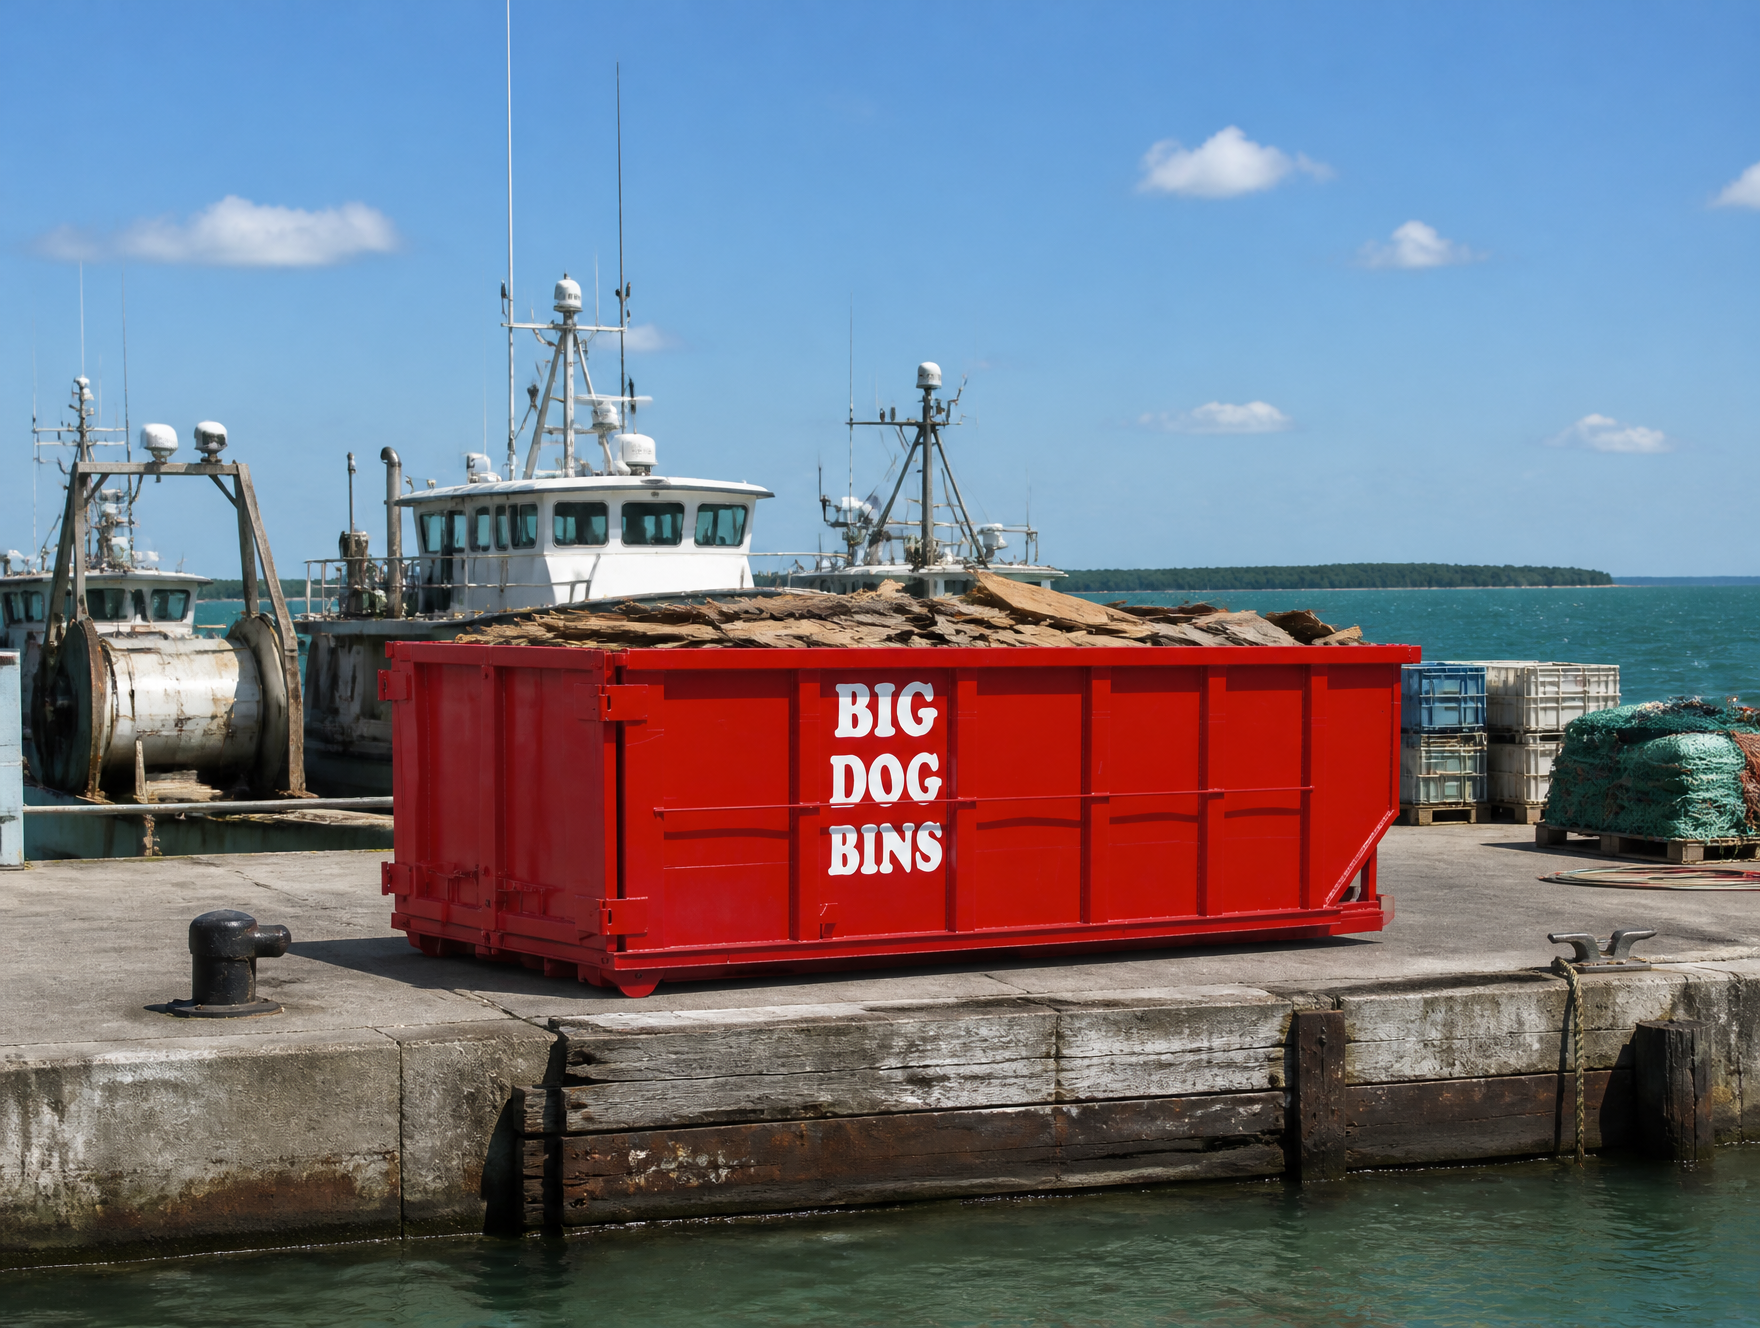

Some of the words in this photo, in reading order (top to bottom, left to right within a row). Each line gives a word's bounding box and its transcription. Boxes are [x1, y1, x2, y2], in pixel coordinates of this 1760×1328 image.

[834, 681, 938, 738] BIG
[829, 752, 942, 808] DOG
[828, 821, 943, 876] BINS
